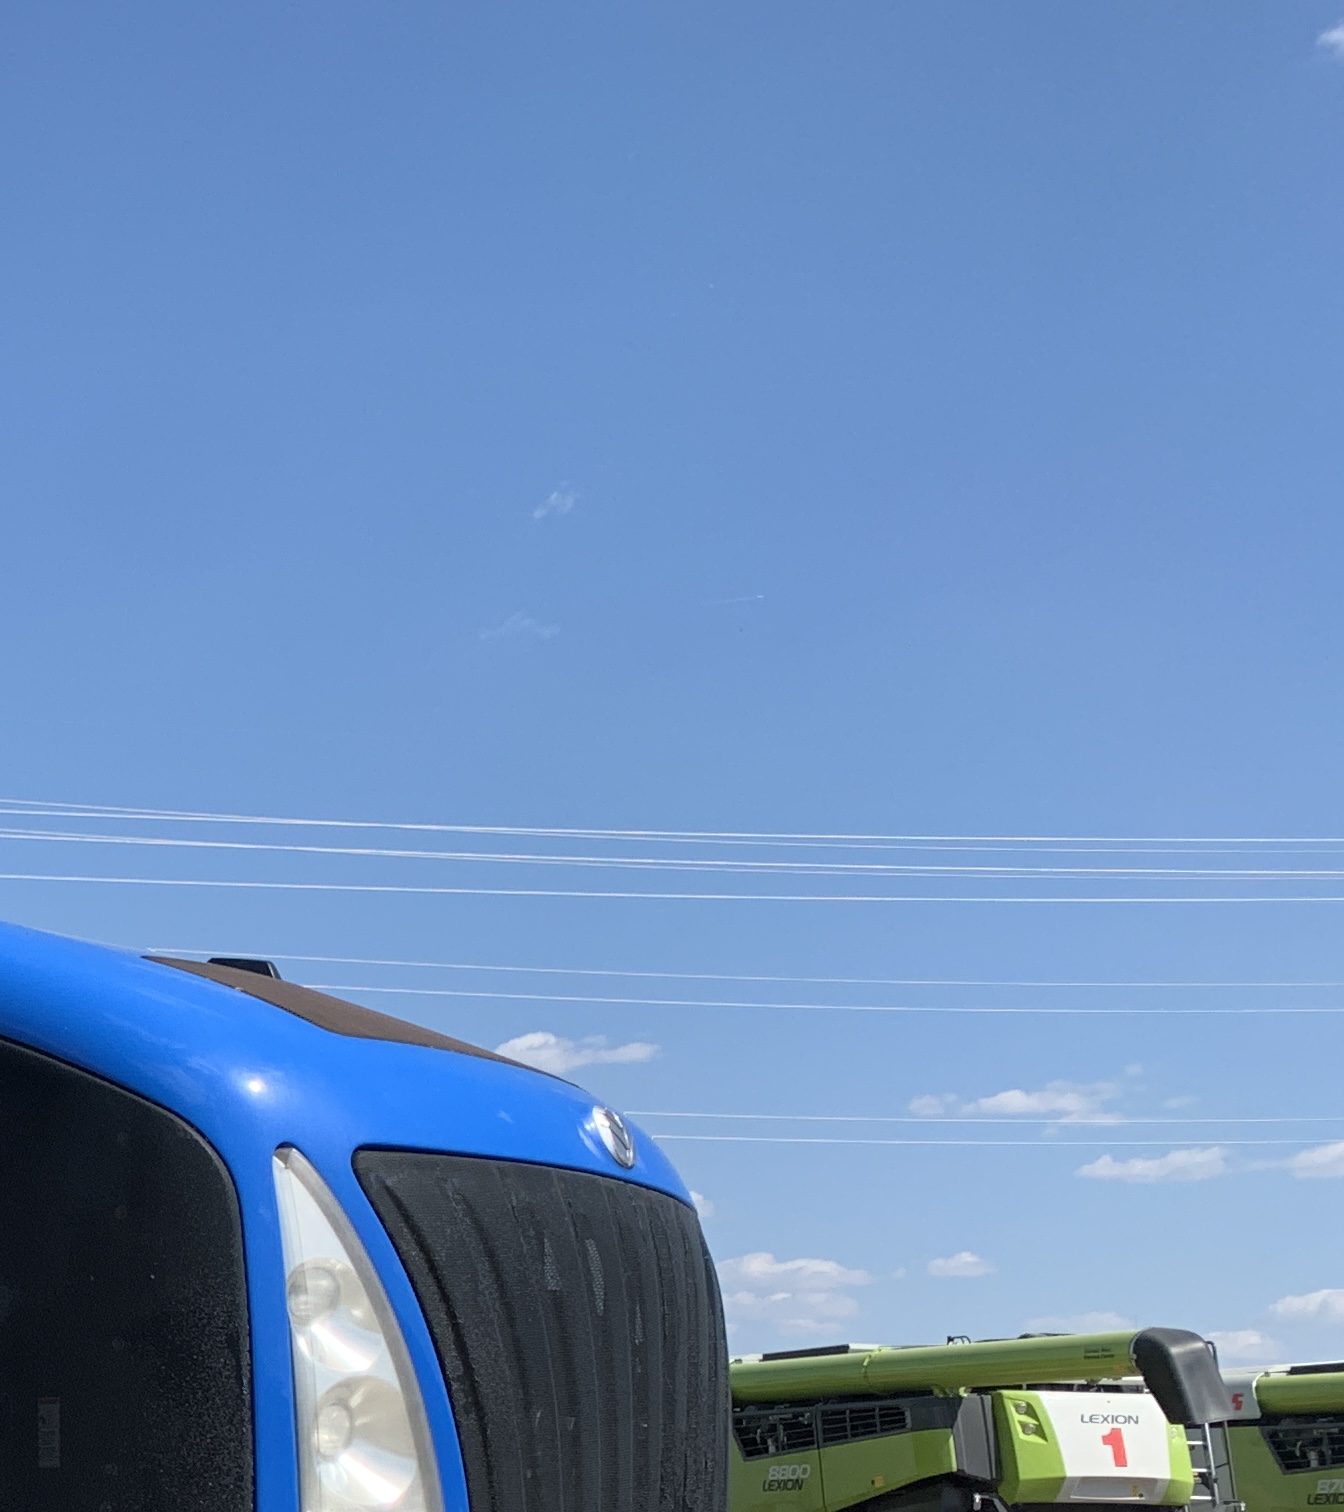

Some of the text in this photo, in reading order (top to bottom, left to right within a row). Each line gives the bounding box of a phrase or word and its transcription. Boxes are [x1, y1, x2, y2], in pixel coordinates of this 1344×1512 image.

[1080, 1413, 1140, 1426] LEXION
[1101, 1427, 1128, 1468] 1
[762, 1479, 804, 1492] LEXION
[1306, 1492, 1344, 1506] LEXIO
